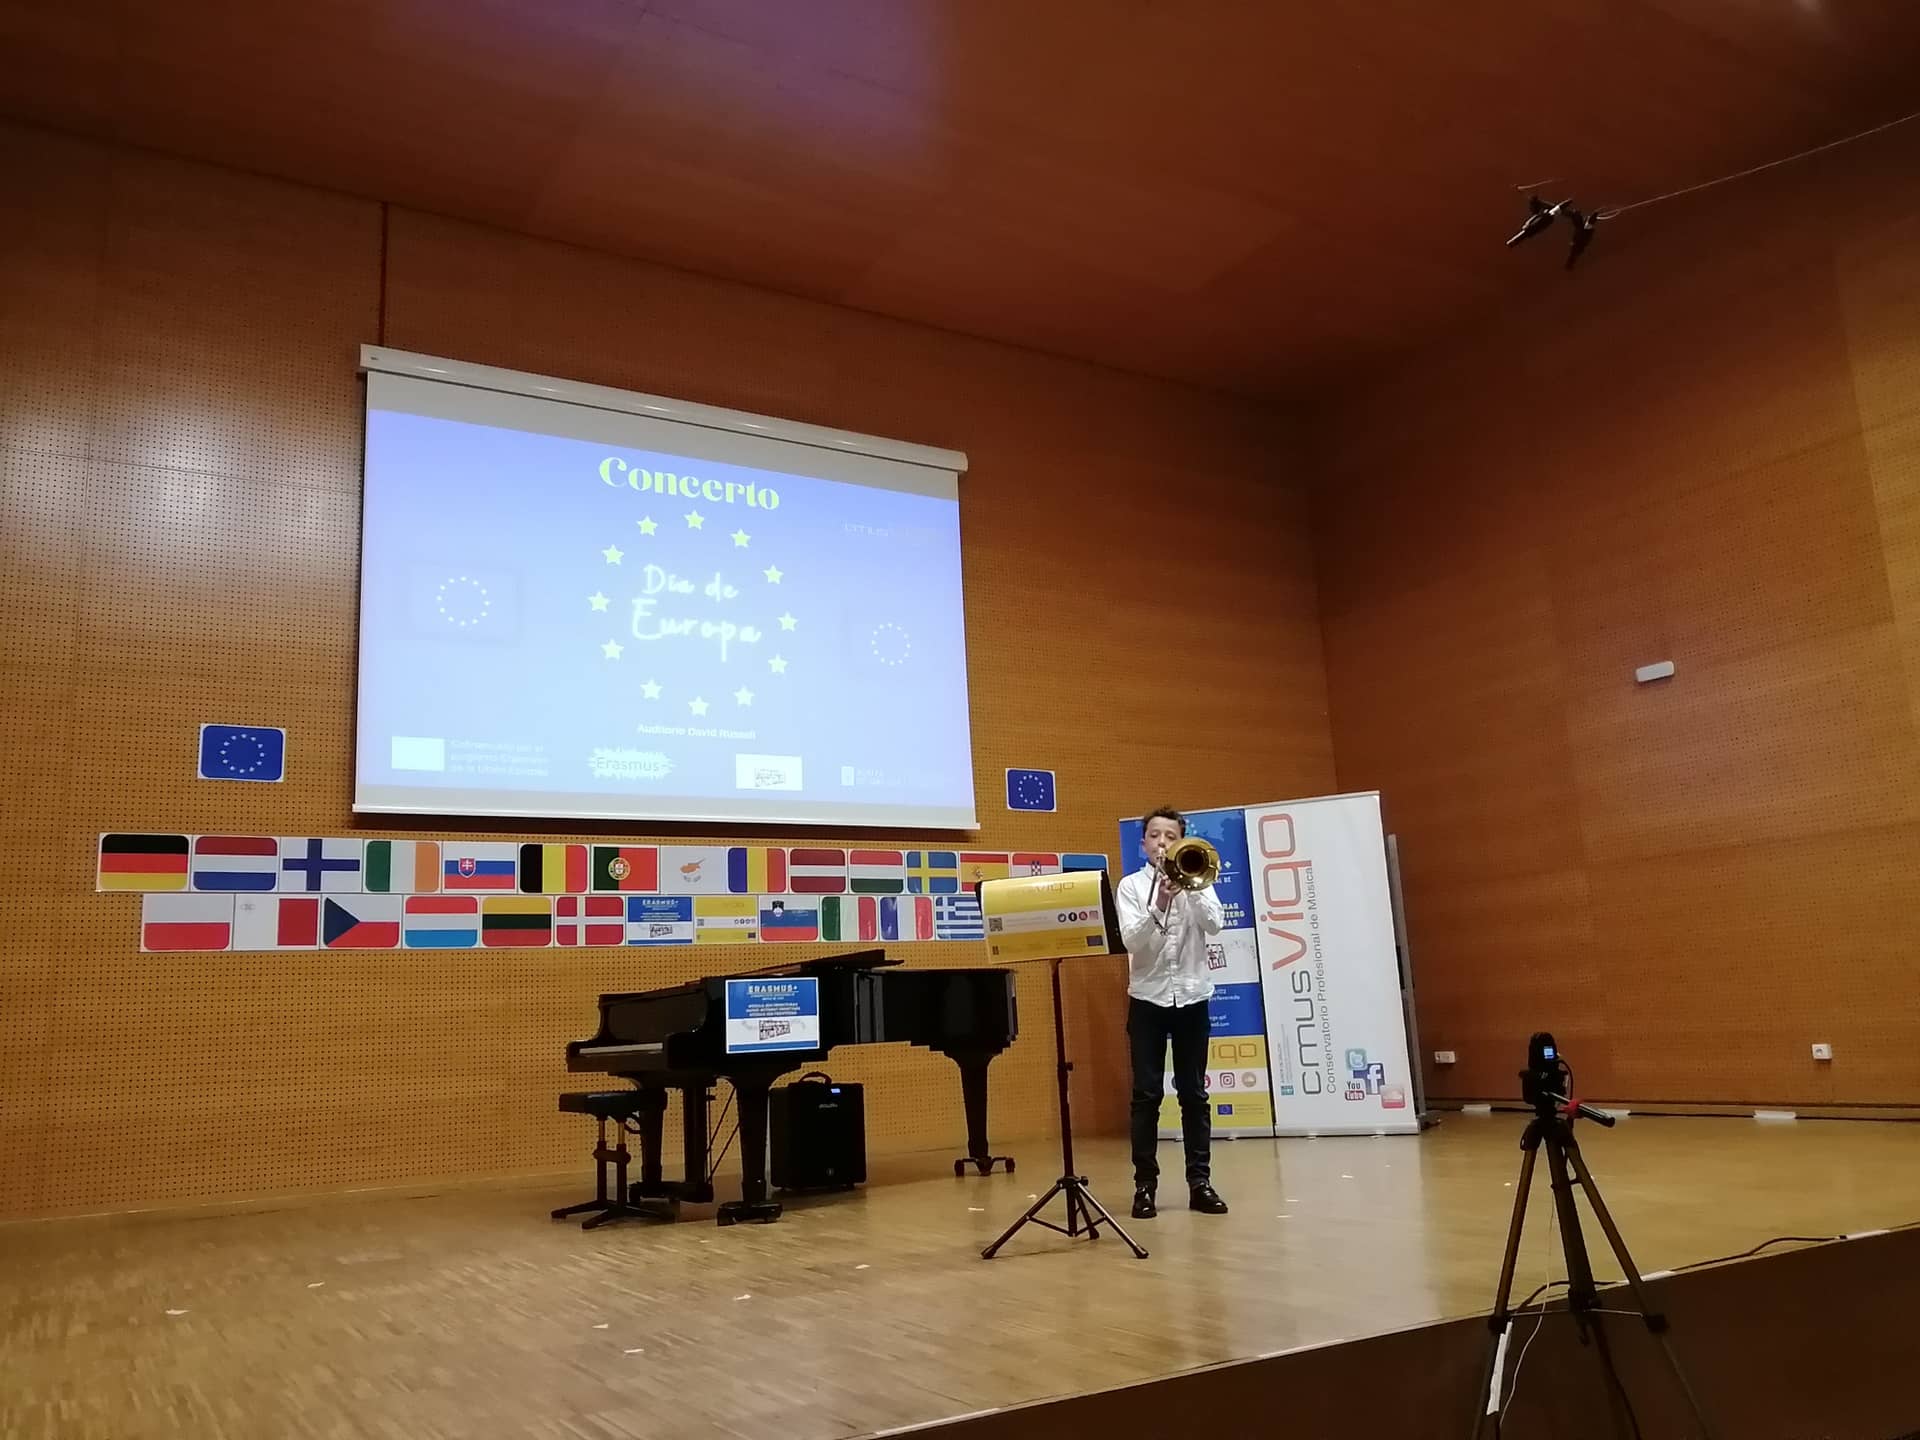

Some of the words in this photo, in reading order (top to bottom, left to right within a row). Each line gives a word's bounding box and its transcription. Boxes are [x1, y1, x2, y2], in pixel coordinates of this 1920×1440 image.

[599, 457, 780, 510] Concerto
[705, 572, 739, 602] de
[632, 599, 762, 662] Europa
[688, 726, 717, 737] David
[1306, 867, 1318, 910] Música
[1309, 914, 1319, 929] de
[1311, 933, 1327, 1002] Profesional
[748, 984, 798, 993] ERASMUS+
[1320, 1005, 1337, 1094] Conservatorio
[1346, 1080, 1361, 1090] You
